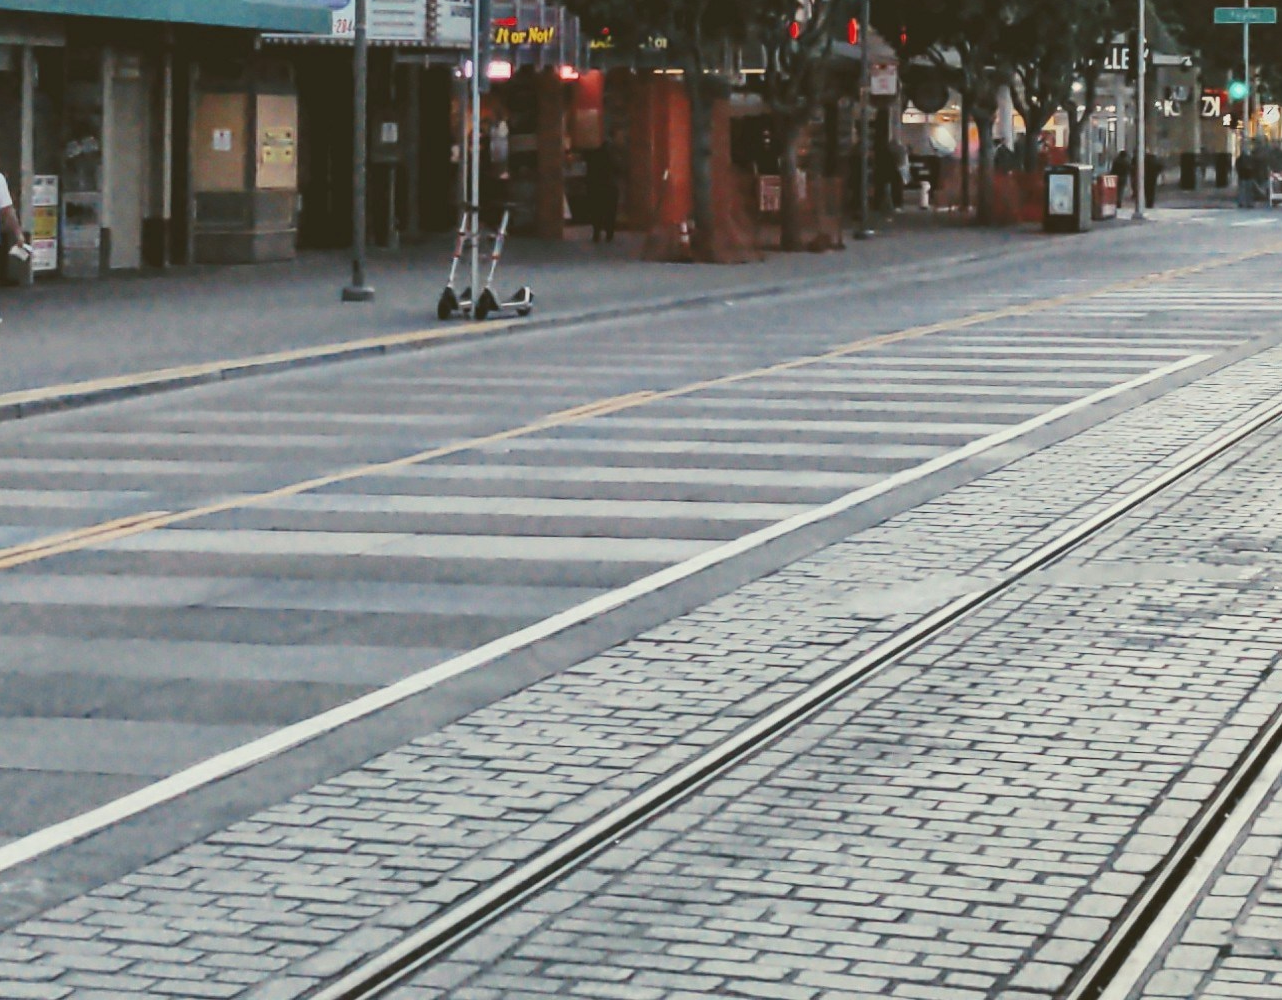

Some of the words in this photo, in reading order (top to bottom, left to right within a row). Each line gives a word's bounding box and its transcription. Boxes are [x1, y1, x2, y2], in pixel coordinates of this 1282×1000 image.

[495, 27, 509, 44] It
[510, 31, 527, 44] or
[528, 26, 555, 44] Not!
